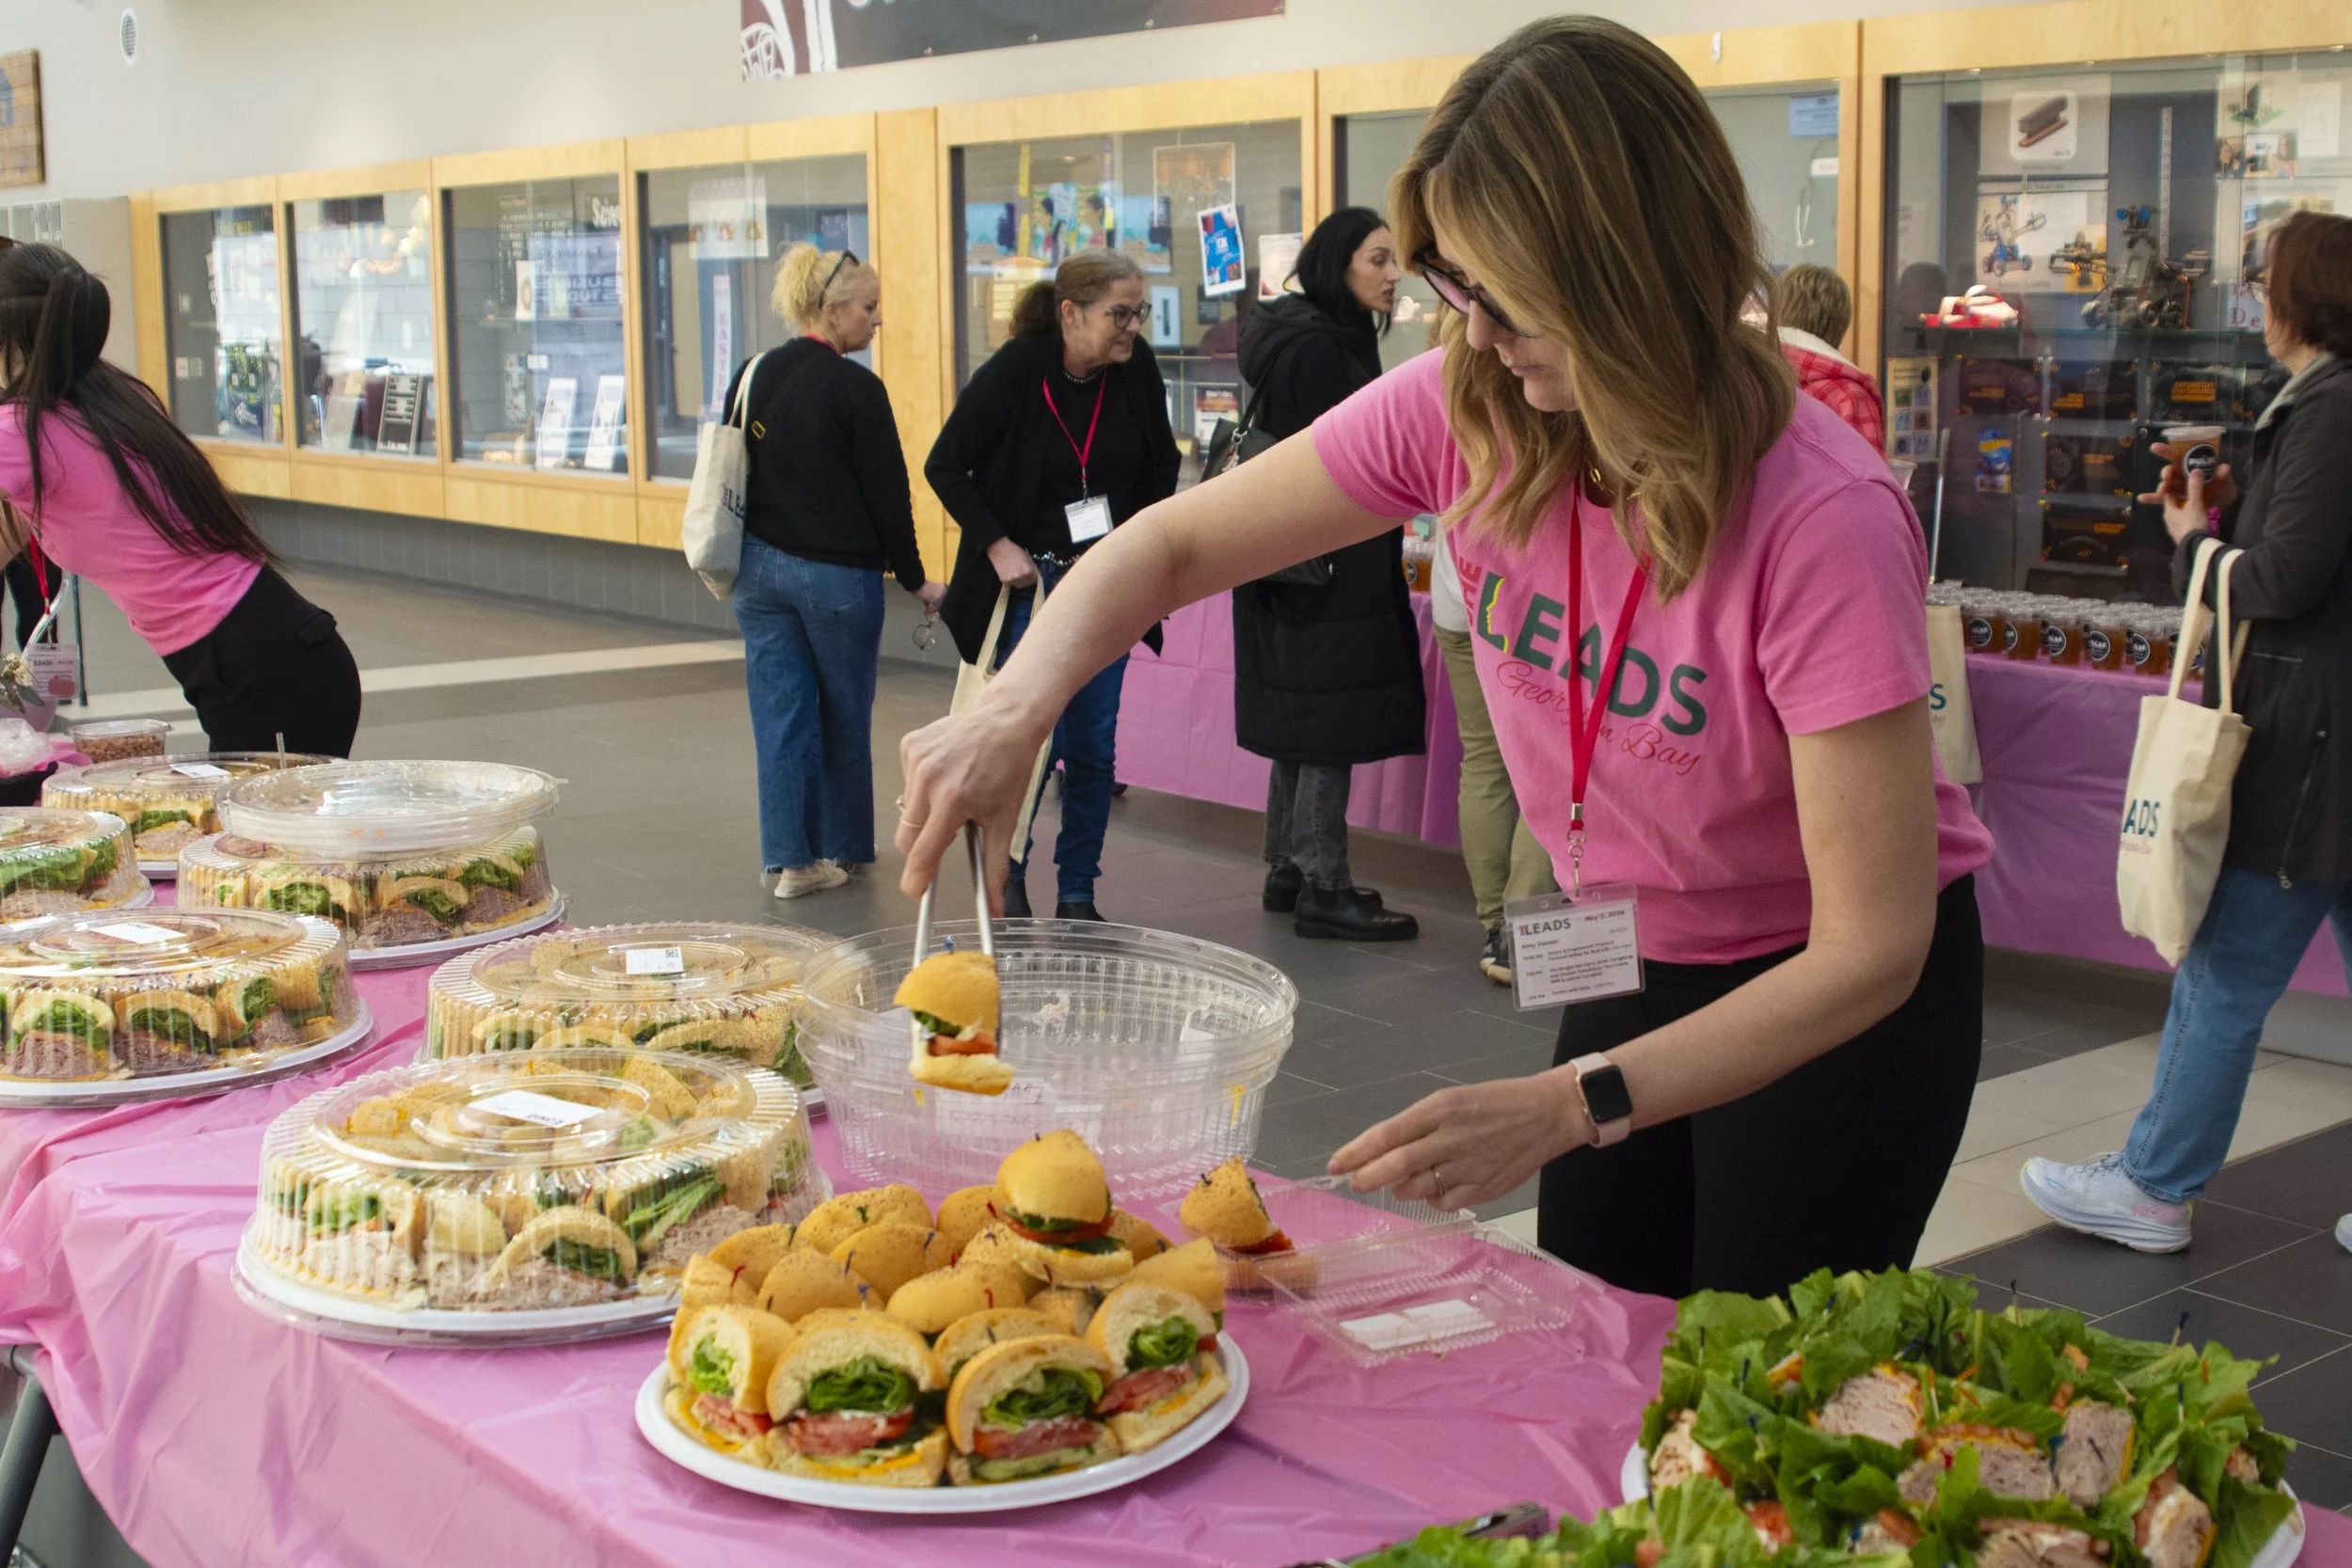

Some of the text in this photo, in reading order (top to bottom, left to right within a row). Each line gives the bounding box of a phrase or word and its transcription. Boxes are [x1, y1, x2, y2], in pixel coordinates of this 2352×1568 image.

[1477, 571, 1708, 736] LEADS
[1621, 722, 1702, 776] Bay
[1525, 918, 1571, 936] LEADS
